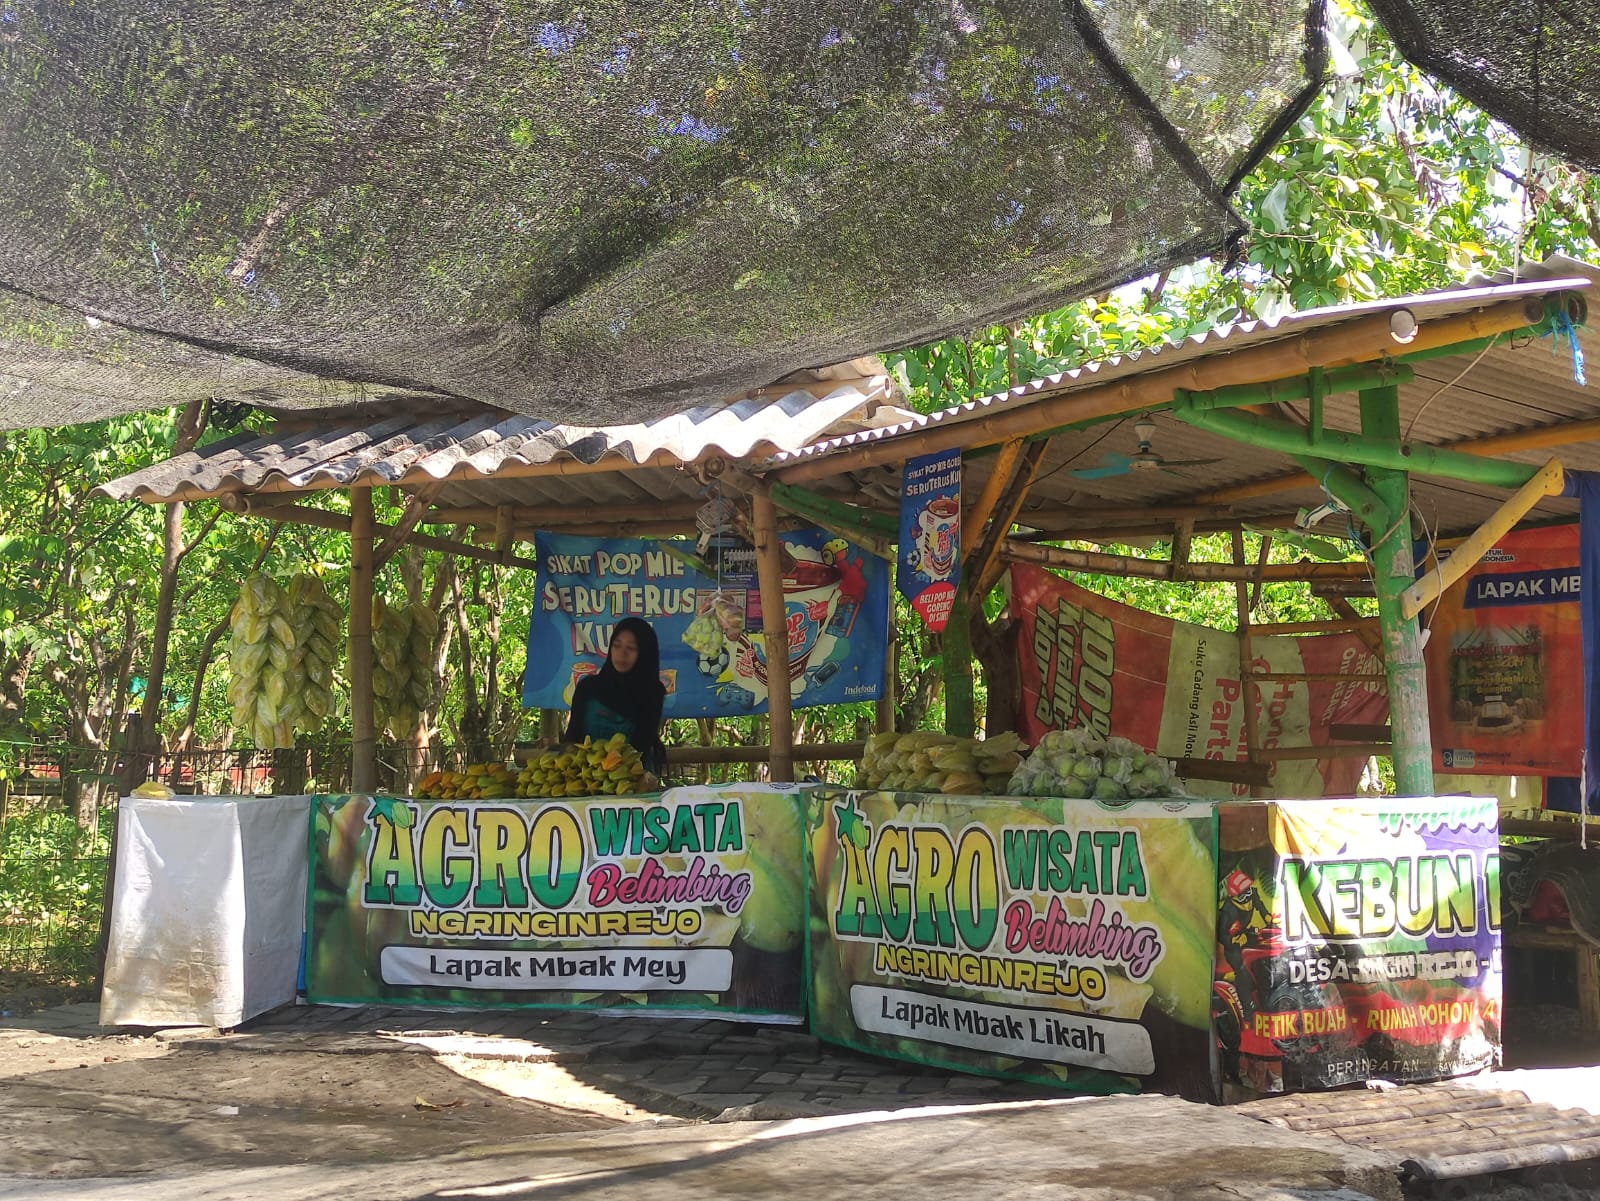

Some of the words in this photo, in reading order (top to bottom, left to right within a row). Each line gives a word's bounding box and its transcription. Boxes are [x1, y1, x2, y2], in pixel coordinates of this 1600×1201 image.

[547, 553, 591, 575] SIKAT
[595, 550, 642, 578] POP
[644, 551, 685, 579] MIE
[1477, 579, 1544, 599] LAPAK
[1550, 576, 1581, 594] MB
[1052, 598, 1081, 731] Kualit
[1077, 608, 1116, 742] 100%
[1196, 640, 1207, 667] Suku
[1189, 670, 1204, 709] Cadang
[1188, 712, 1200, 731] Asli
[1204, 678, 1242, 761] Parts
[1183, 734, 1196, 759] Moto
[364, 803, 585, 909] AGRO
[590, 803, 743, 856] WISATA
[587, 858, 751, 912] Belimbing
[836, 826, 999, 952] AGRO
[1003, 829, 1147, 897] WISATA
[412, 910, 700, 936] NGRINGINREJO
[1282, 854, 1478, 939] KEBUN
[1004, 895, 1161, 977] Belimbing
[430, 955, 521, 980] Lapak
[530, 955, 615, 978] Mbak
[623, 956, 686, 984] Mey
[876, 944, 1106, 1000] NGRINGINREJO
[1289, 957, 1349, 984] DESA
[881, 995, 950, 1031] Lapak
[954, 1008, 1024, 1040] Mbak
[1029, 1017, 1106, 1055] Likah
[1254, 1013, 1297, 1039] PETIK
[1303, 1010, 1347, 1034] BUAH
[1367, 1006, 1418, 1032] RUMAH
[1420, 1001, 1472, 1027] POHON
[1327, 1058, 1421, 1077] PERINGATAN
